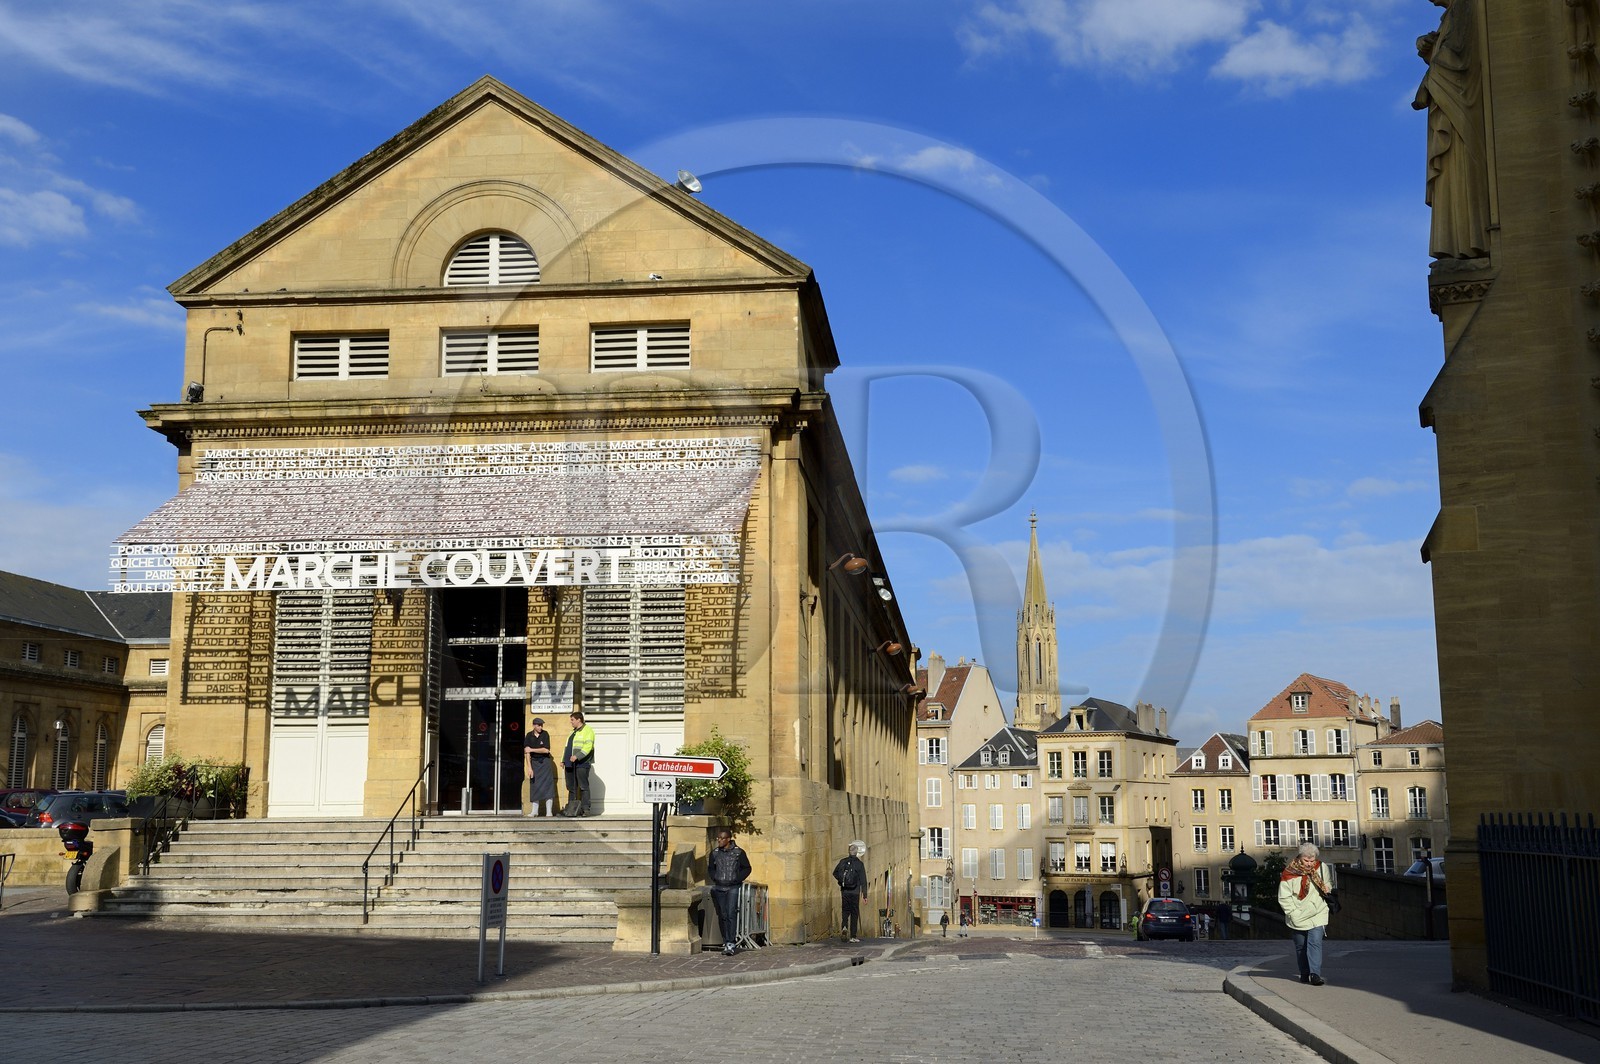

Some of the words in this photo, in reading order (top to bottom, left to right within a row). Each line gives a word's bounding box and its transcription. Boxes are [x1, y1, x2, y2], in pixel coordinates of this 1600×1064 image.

[205, 447, 250, 458] MARCHÉ
[253, 447, 304, 459] COUVERT,
[307, 446, 335, 456] HAUT
[340, 446, 362, 456] LIEU
[365, 446, 380, 456] DE
[381, 446, 395, 455] LA
[398, 444, 473, 455] GASTRONOMIE
[594, 441, 607, 451] LE
[610, 438, 656, 450] MARCHÉ
[659, 438, 709, 448] COUVERT
[712, 437, 751, 447] DEVAIT
[216, 460, 276, 470] ACCUEILLIR
[277, 460, 296, 469] DES
[300, 458, 344, 469] PRÉLATS
[346, 459, 358, 467] ET
[362, 458, 388, 468] NON
[389, 458, 409, 467] DES
[488, 453, 529, 464] RÉALISÉ
[610, 450, 625, 461] EN
[628, 450, 665, 460] PIERRE
[667, 450, 680, 459] DE
[195, 472, 240, 482] L'ANCIEN
[287, 470, 330, 480] DEVENU
[332, 467, 377, 479] MARCHÉ
[381, 468, 429, 478] COUVERT
[432, 468, 446, 477] DE
[448, 467, 478, 477] METZ
[480, 466, 526, 476] OUVRIRA
[528, 464, 616, 475] OFFICIELLEMENT
[619, 463, 637, 473] SES
[640, 462, 681, 472] PORTES
[684, 462, 700, 471] EN
[117, 545, 151, 555] PORC
[182, 544, 208, 554] AUX
[287, 542, 334, 552] TOURTE
[401, 540, 452, 550] COCHON
[455, 539, 471, 549] DE
[474, 538, 500, 548] LAIT
[502, 537, 519, 547] EN
[565, 536, 616, 547] POISSON
[632, 536, 648, 545] LA
[690, 535, 708, 545] AU
[634, 548, 681, 558] BOUDIN
[683, 548, 699, 557] DE
[110, 557, 155, 568] QUICHE
[157, 556, 217, 568] LORRAINE,
[224, 550, 413, 591] MARCHÉ
[419, 549, 631, 588] COUVERT
[634, 574, 681, 584] FUSEAU
[114, 583, 160, 592] BOULET
[164, 583, 178, 592] DE
[652, 762, 693, 772] Cathédrale
